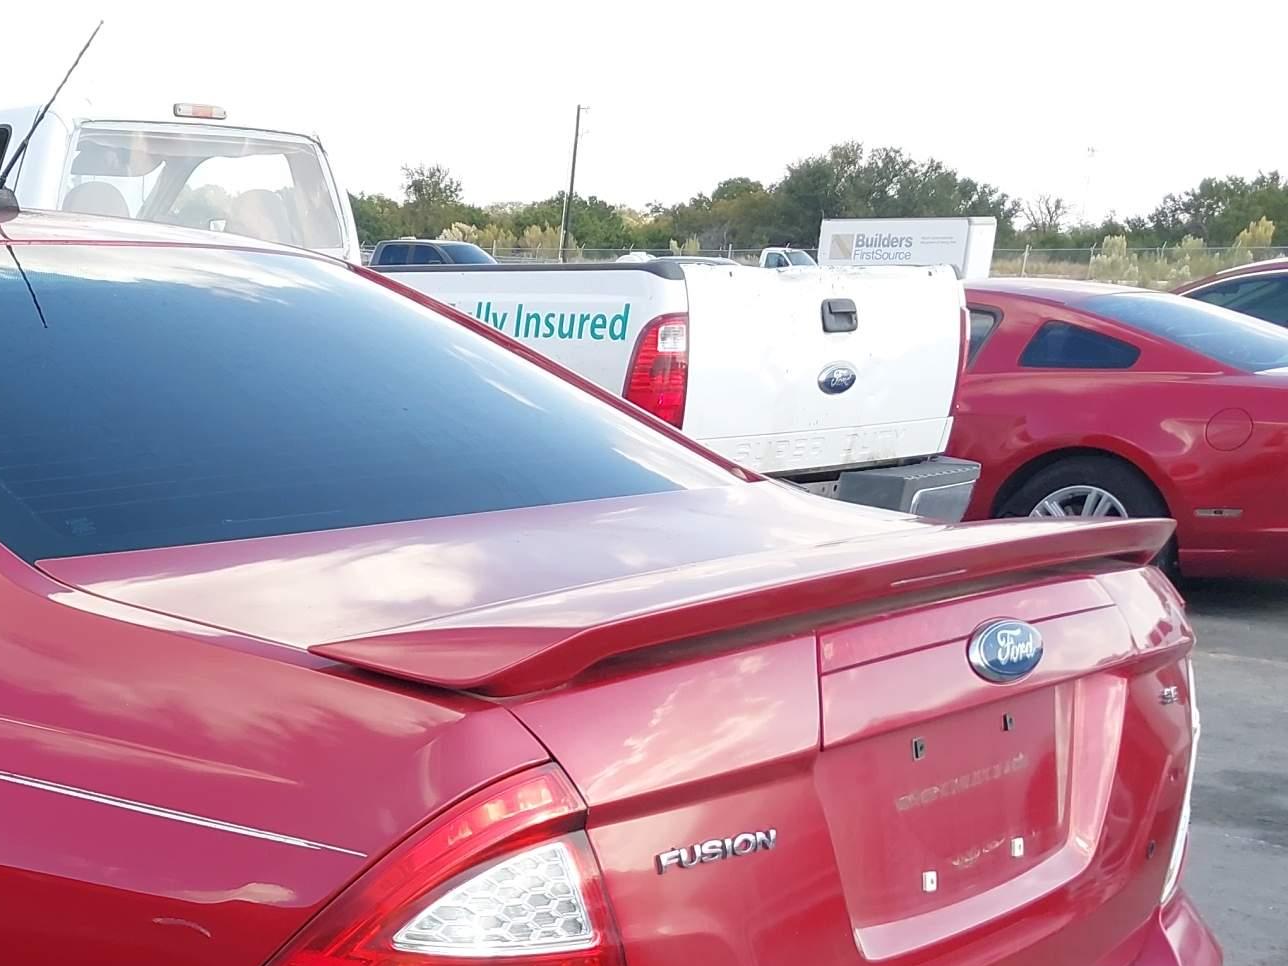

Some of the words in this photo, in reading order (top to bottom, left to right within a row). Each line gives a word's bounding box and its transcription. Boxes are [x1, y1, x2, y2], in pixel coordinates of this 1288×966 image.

[853, 249, 912, 262] FirstSource
[855, 234, 913, 248] Builders
[514, 303, 631, 340] Insured
[996, 628, 1037, 665] Ford
[654, 827, 777, 875] FUSION
